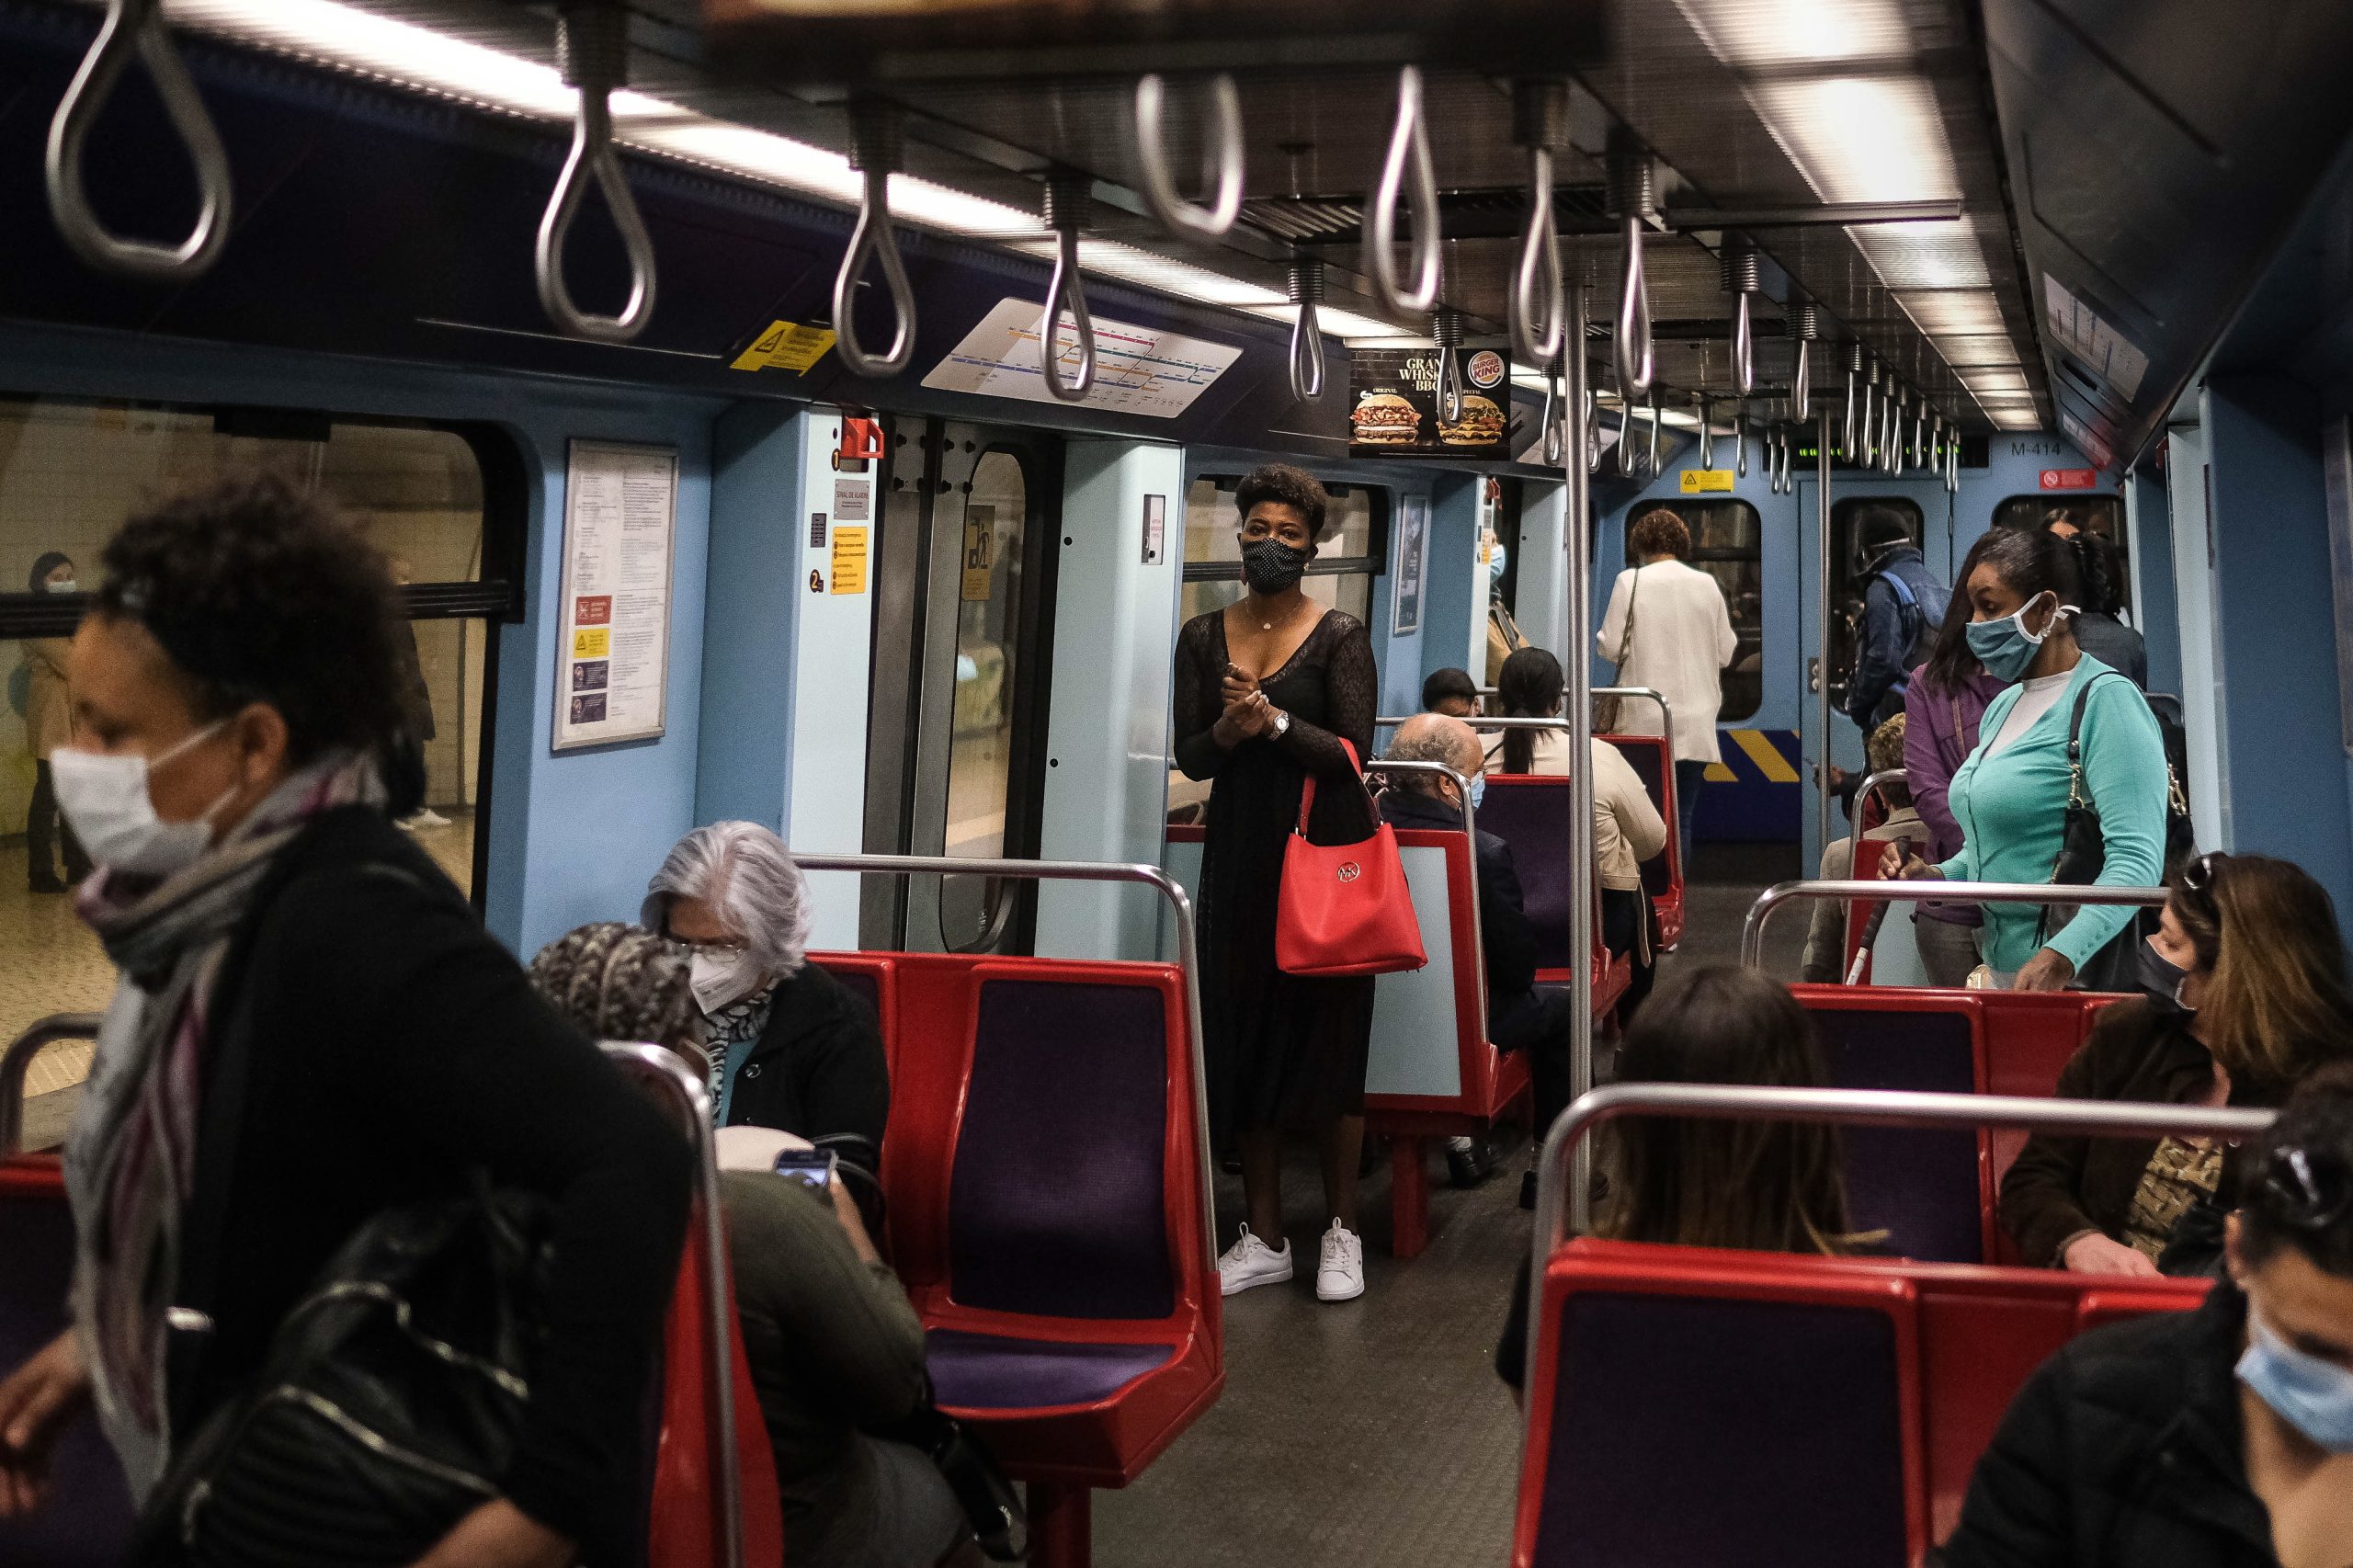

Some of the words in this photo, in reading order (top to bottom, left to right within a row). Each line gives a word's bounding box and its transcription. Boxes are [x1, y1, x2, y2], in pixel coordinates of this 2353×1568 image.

[1406, 358, 1441, 372] GRAN
[1472, 358, 1499, 370] BURGER
[1473, 364, 1500, 380] KING
[2011, 442, 2061, 456] M-414
[812, 572, 818, 588] 2
